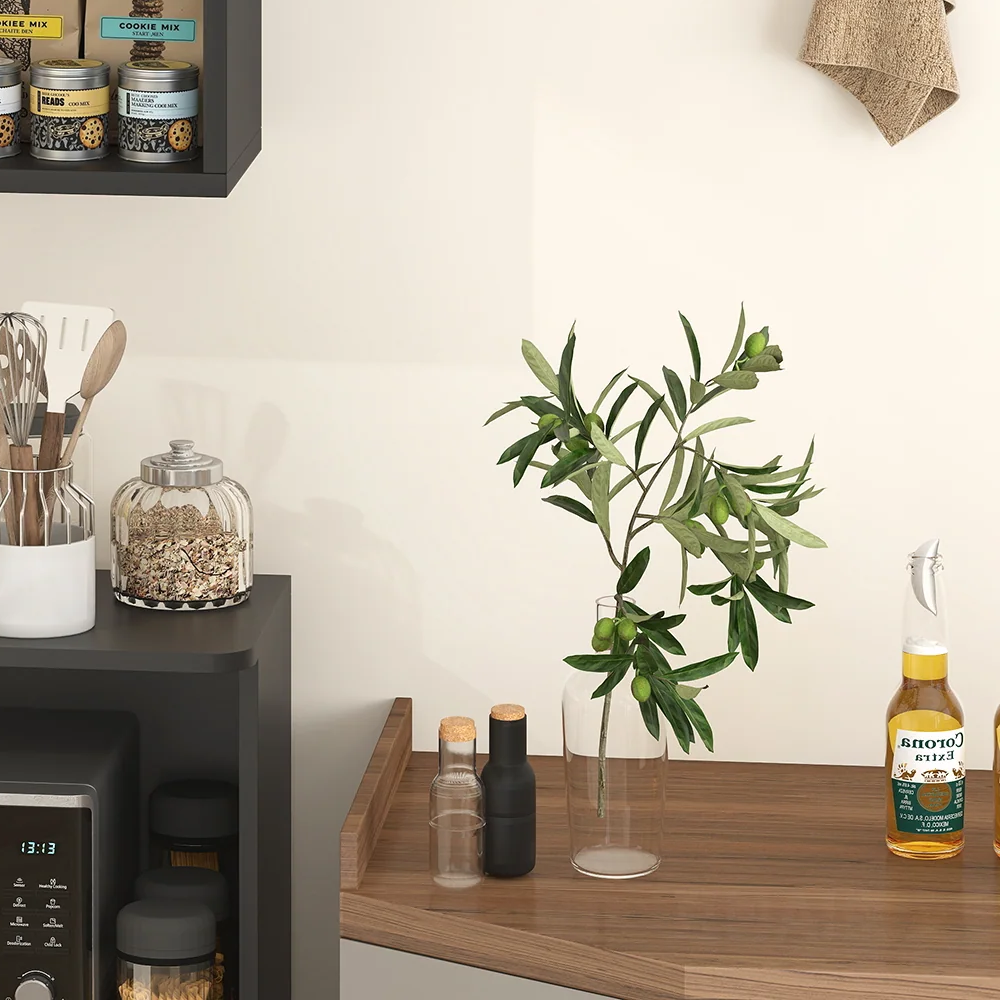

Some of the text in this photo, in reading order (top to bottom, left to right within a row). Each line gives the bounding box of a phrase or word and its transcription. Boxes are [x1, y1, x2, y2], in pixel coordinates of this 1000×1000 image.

[29, 21, 48, 29] MIX
[119, 22, 157, 31] COOKIE
[41, 95, 66, 106] READS
[21, 841, 56, 855] 13:13
